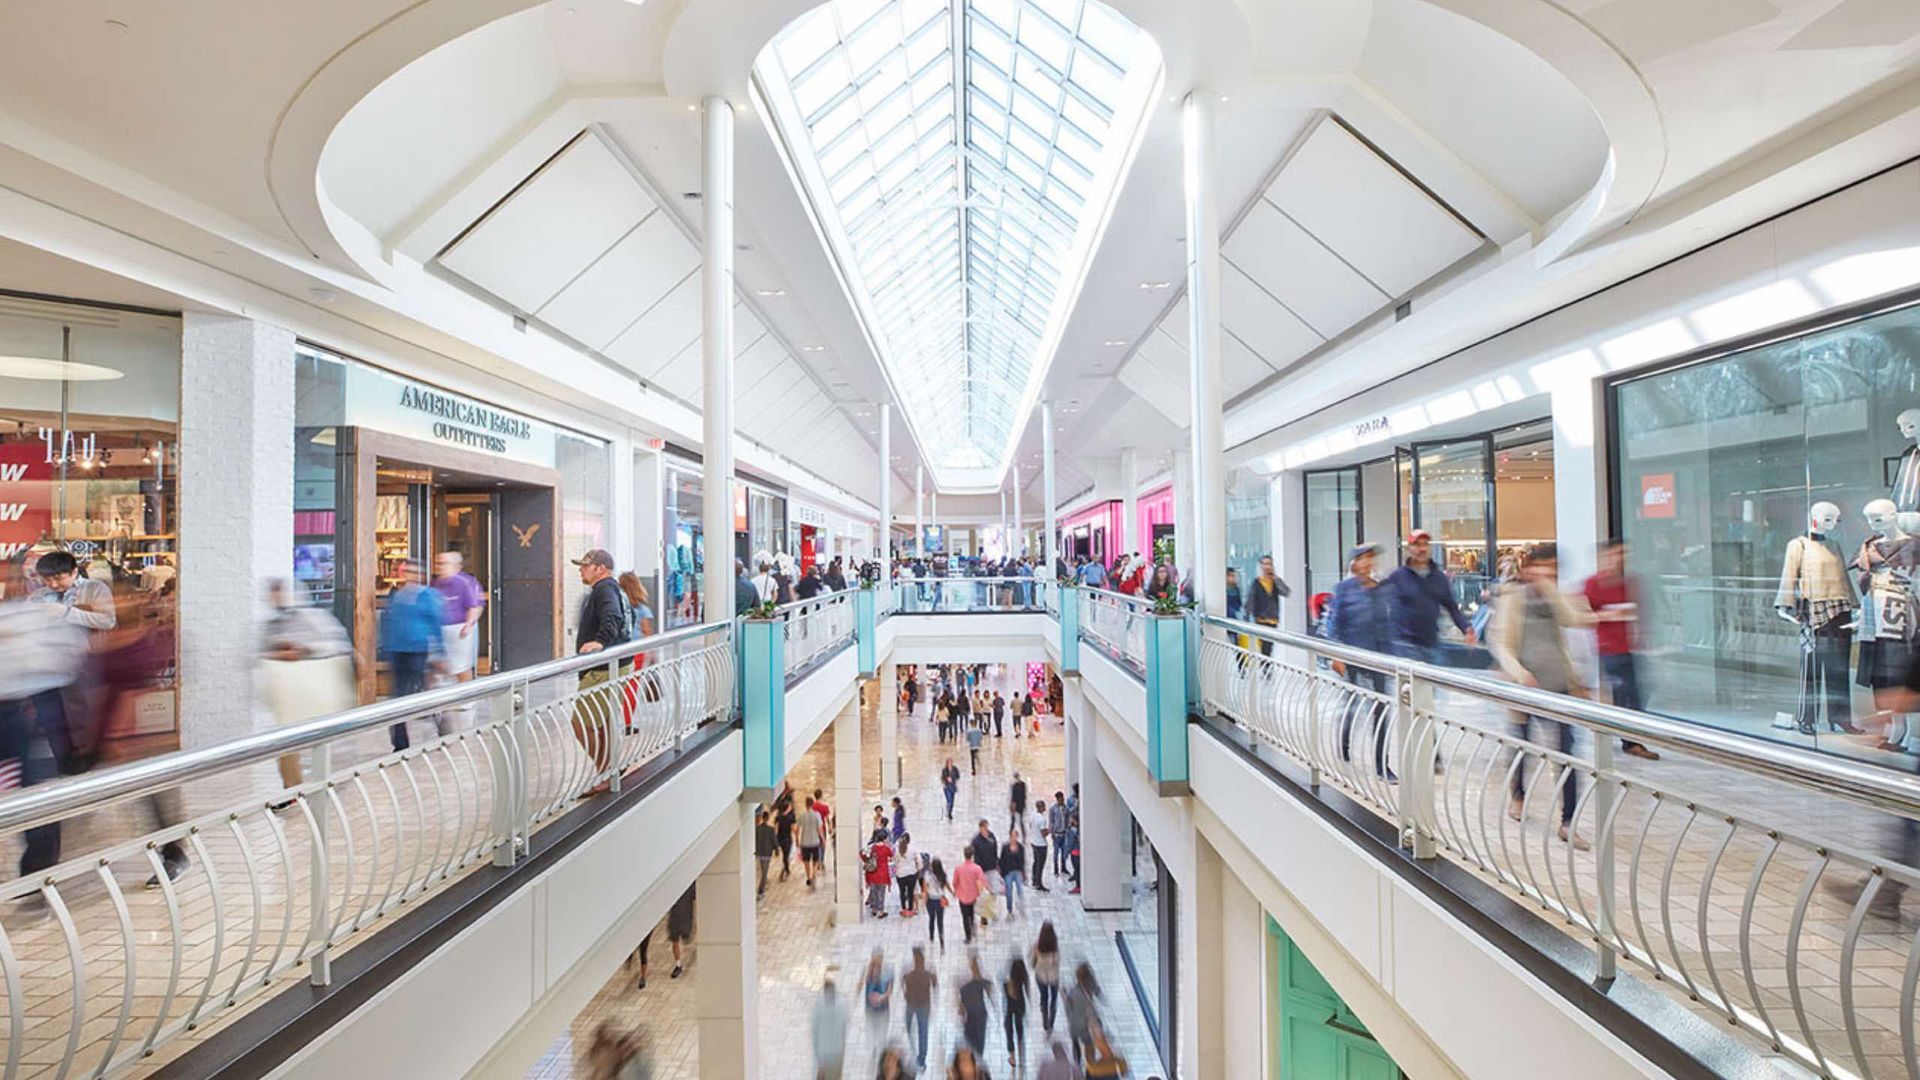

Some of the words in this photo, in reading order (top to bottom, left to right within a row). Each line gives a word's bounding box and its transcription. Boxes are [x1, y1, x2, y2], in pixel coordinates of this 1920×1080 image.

[400, 385, 487, 428] AMERICAN
[490, 411, 530, 439] EAGLE
[433, 421, 506, 453] OUTFITTERS
